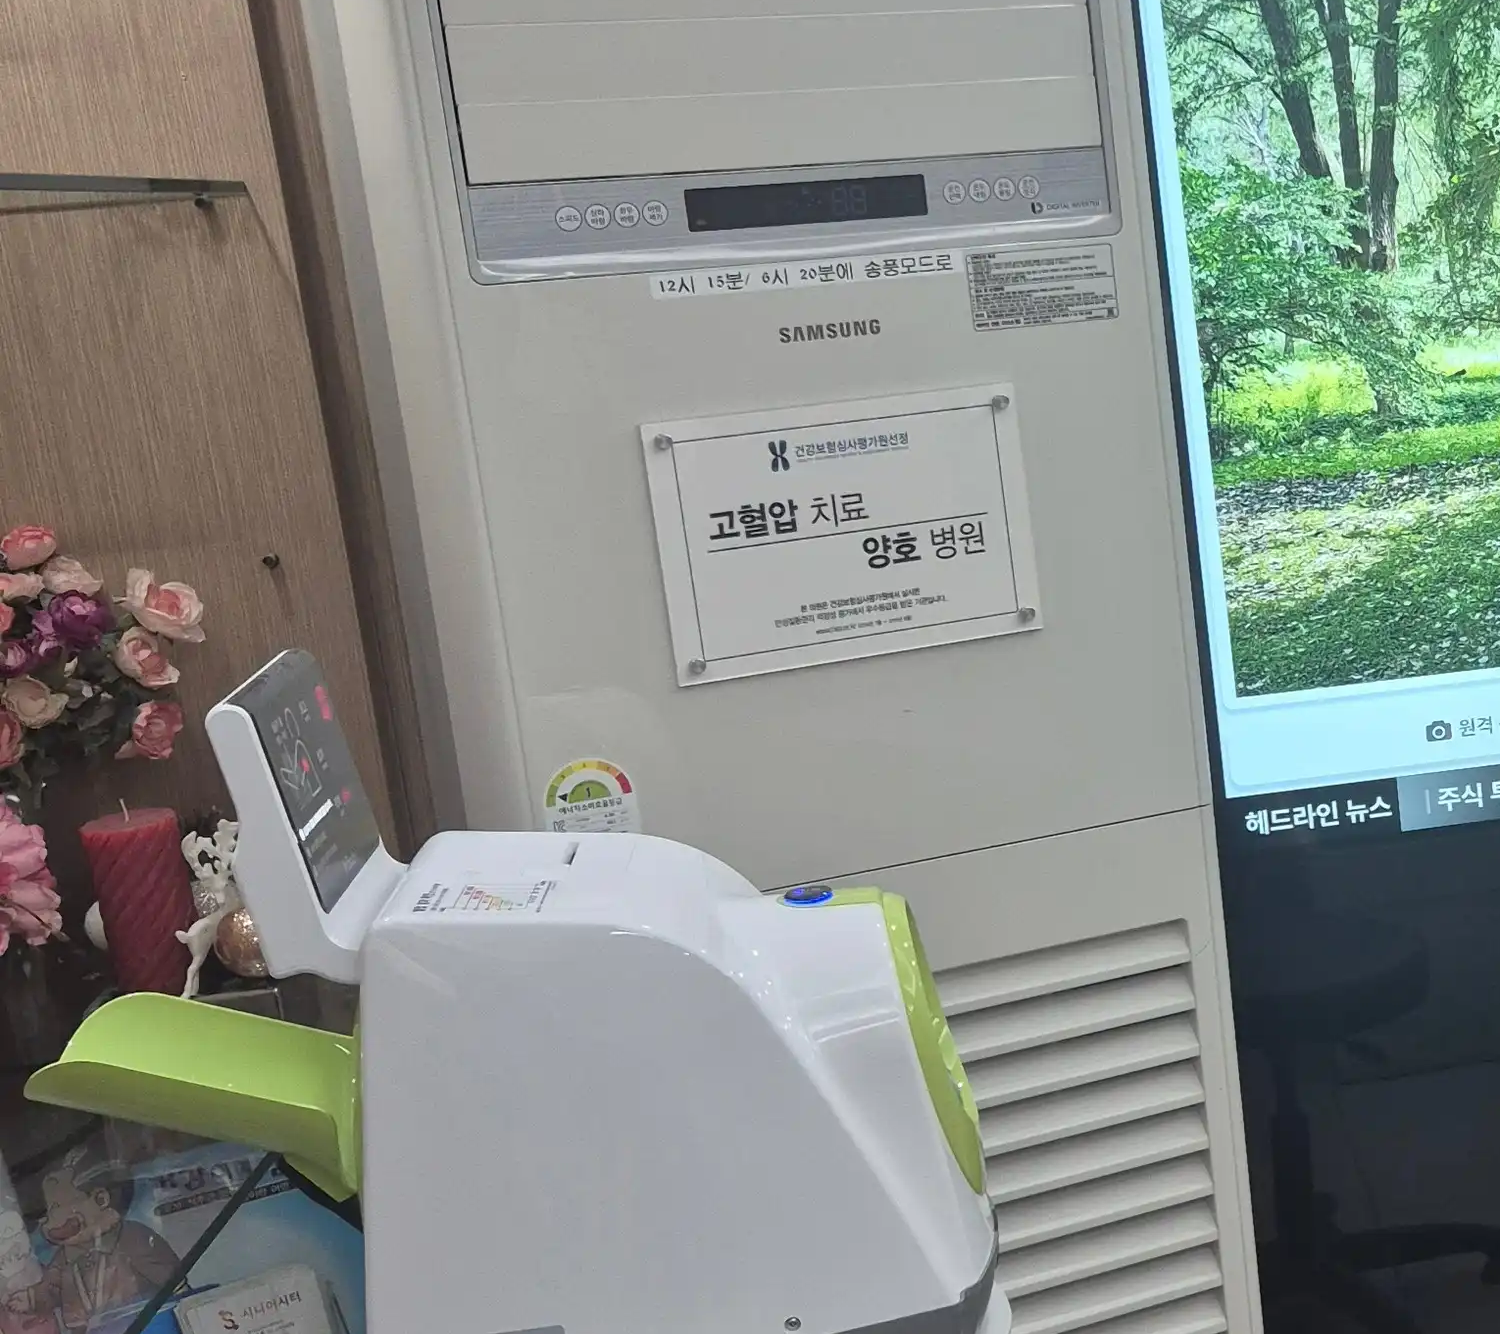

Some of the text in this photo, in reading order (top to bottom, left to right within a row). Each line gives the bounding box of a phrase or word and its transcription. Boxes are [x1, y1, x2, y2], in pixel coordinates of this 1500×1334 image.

[658, 253, 954, 295] 12시 15분/ 6시 20분에 송풍모드로
[778, 318, 882, 344] SAMSUNG
[708, 492, 870, 541] 고혈압 치료
[862, 521, 987, 569] 양호 병원
[1459, 715, 1494, 738] 원격
[1245, 795, 1393, 837] 헤드라인 뉴스
[1438, 785, 1484, 812] 주식
